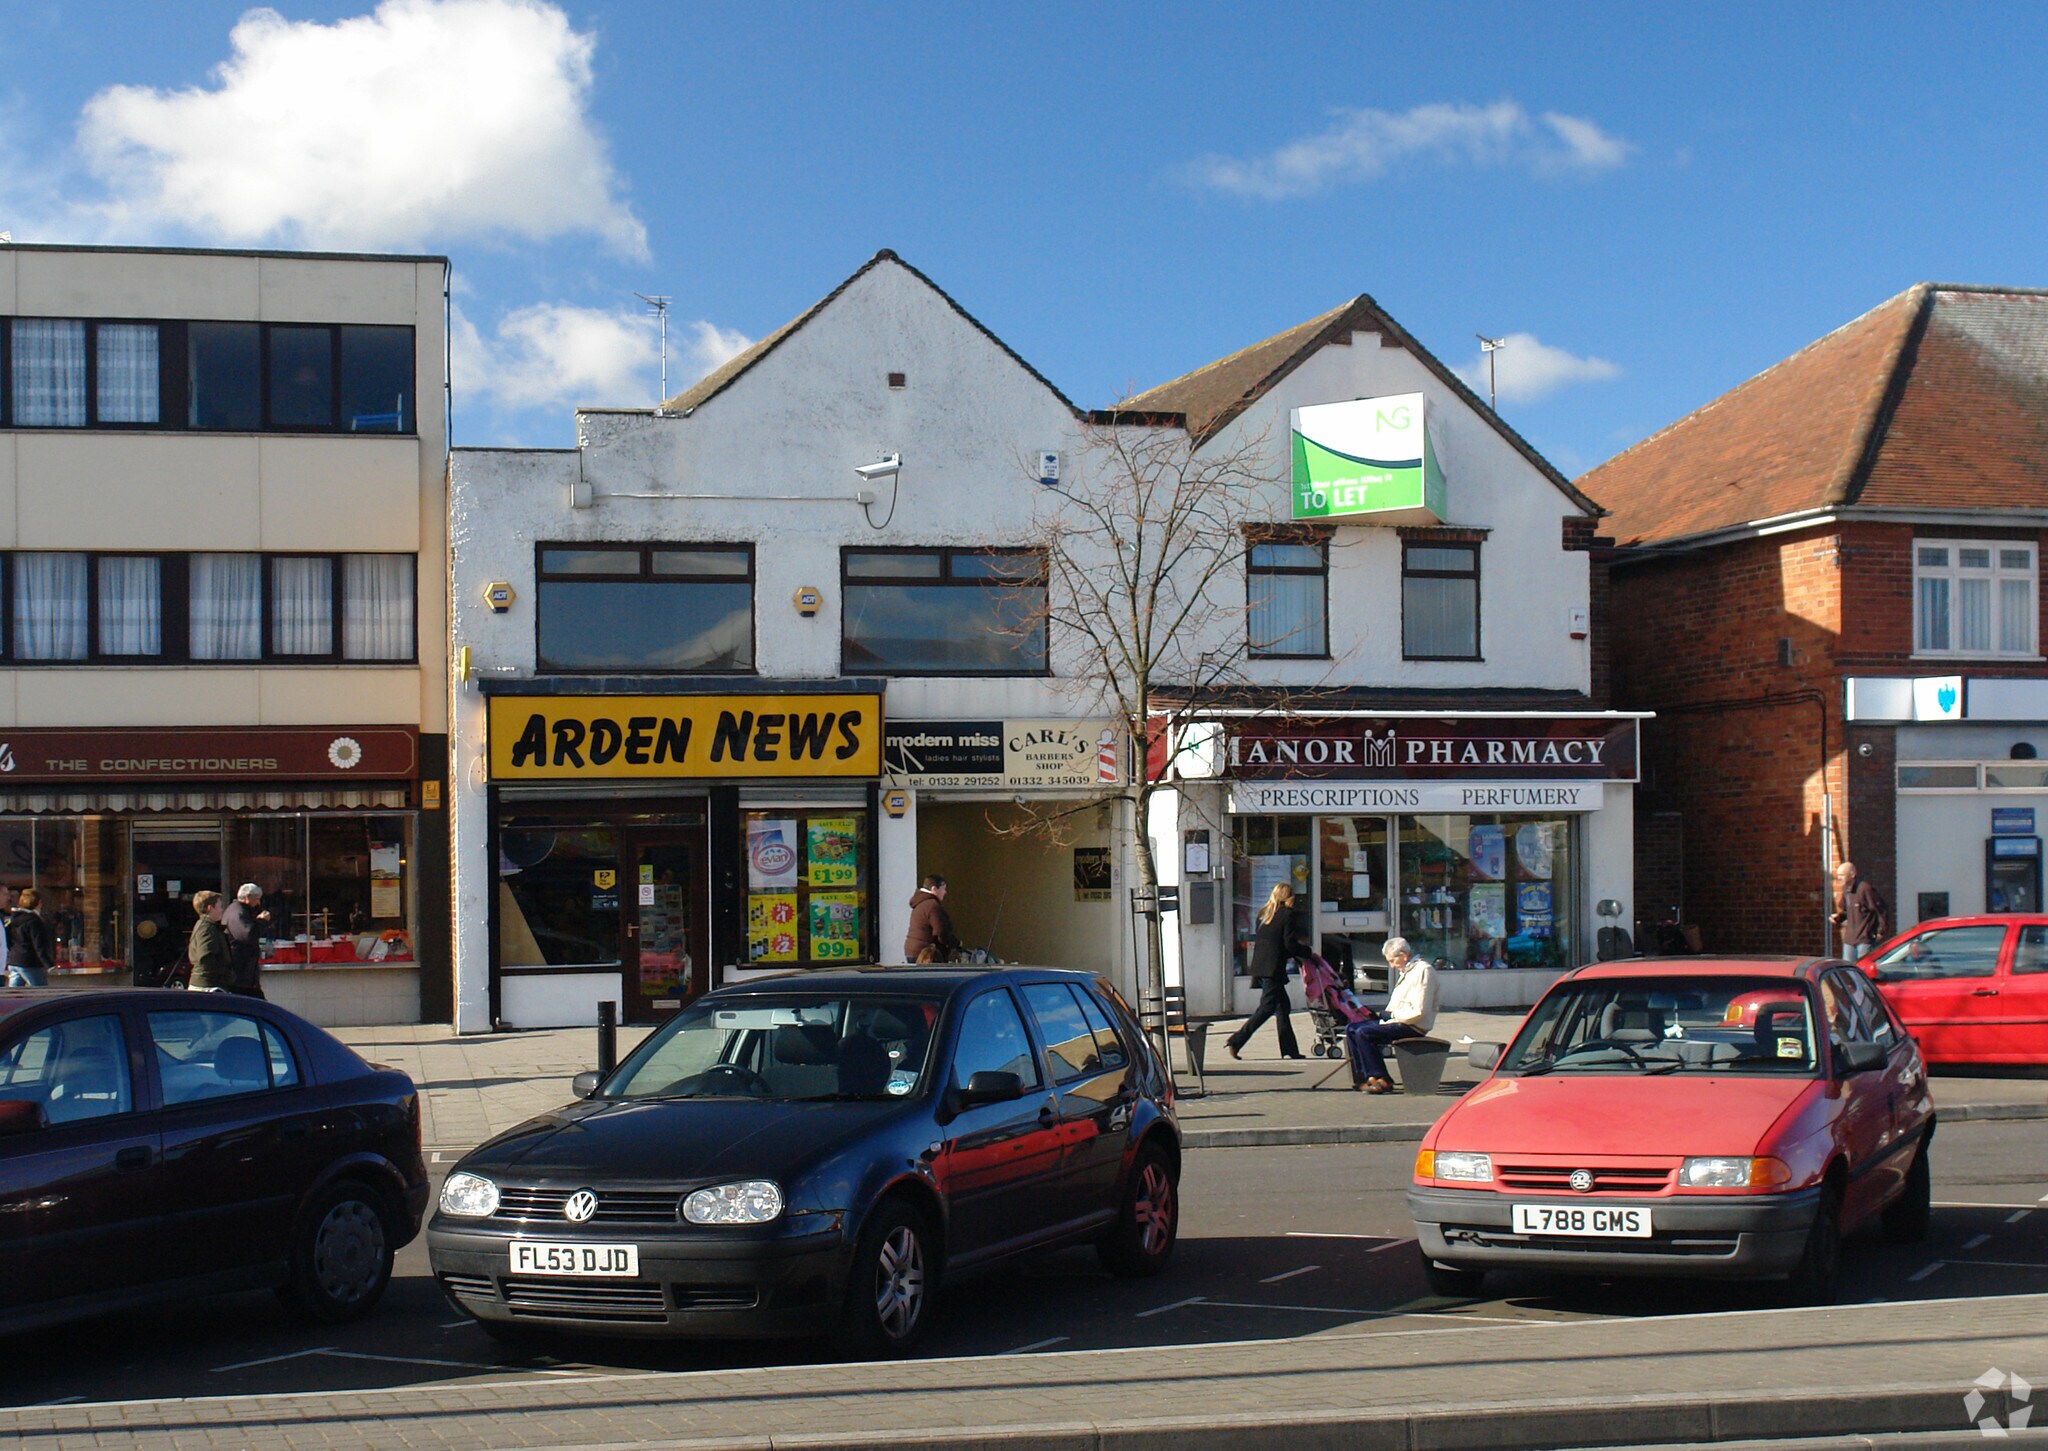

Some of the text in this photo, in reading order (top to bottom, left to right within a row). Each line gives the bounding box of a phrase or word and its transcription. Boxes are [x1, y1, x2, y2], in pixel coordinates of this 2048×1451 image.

[1301, 485, 1368, 509] TO LET
[511, 710, 862, 768] ARDEN NEWS
[886, 733, 1000, 747] modern miss
[1008, 729, 1090, 754] CARL'S
[925, 754, 1000, 764] ladies hair stylists
[1025, 752, 1074, 761] BARBERS
[1405, 740, 1606, 763] PHARMACY
[45, 758, 278, 771] THE CONFECTIONERS
[1036, 762, 1064, 770] SHOP
[909, 776, 1000, 786] tel: 01332 291252
[1010, 775, 1090, 785] 01332 345039
[1261, 788, 1581, 806] PRESCRIPTIONS PERFUMERY
[761, 852, 788, 866] evian
[817, 941, 854, 957] 99p
[1523, 1209, 1640, 1232] L788 GMS
[518, 1246, 629, 1272] FL53 DJD
